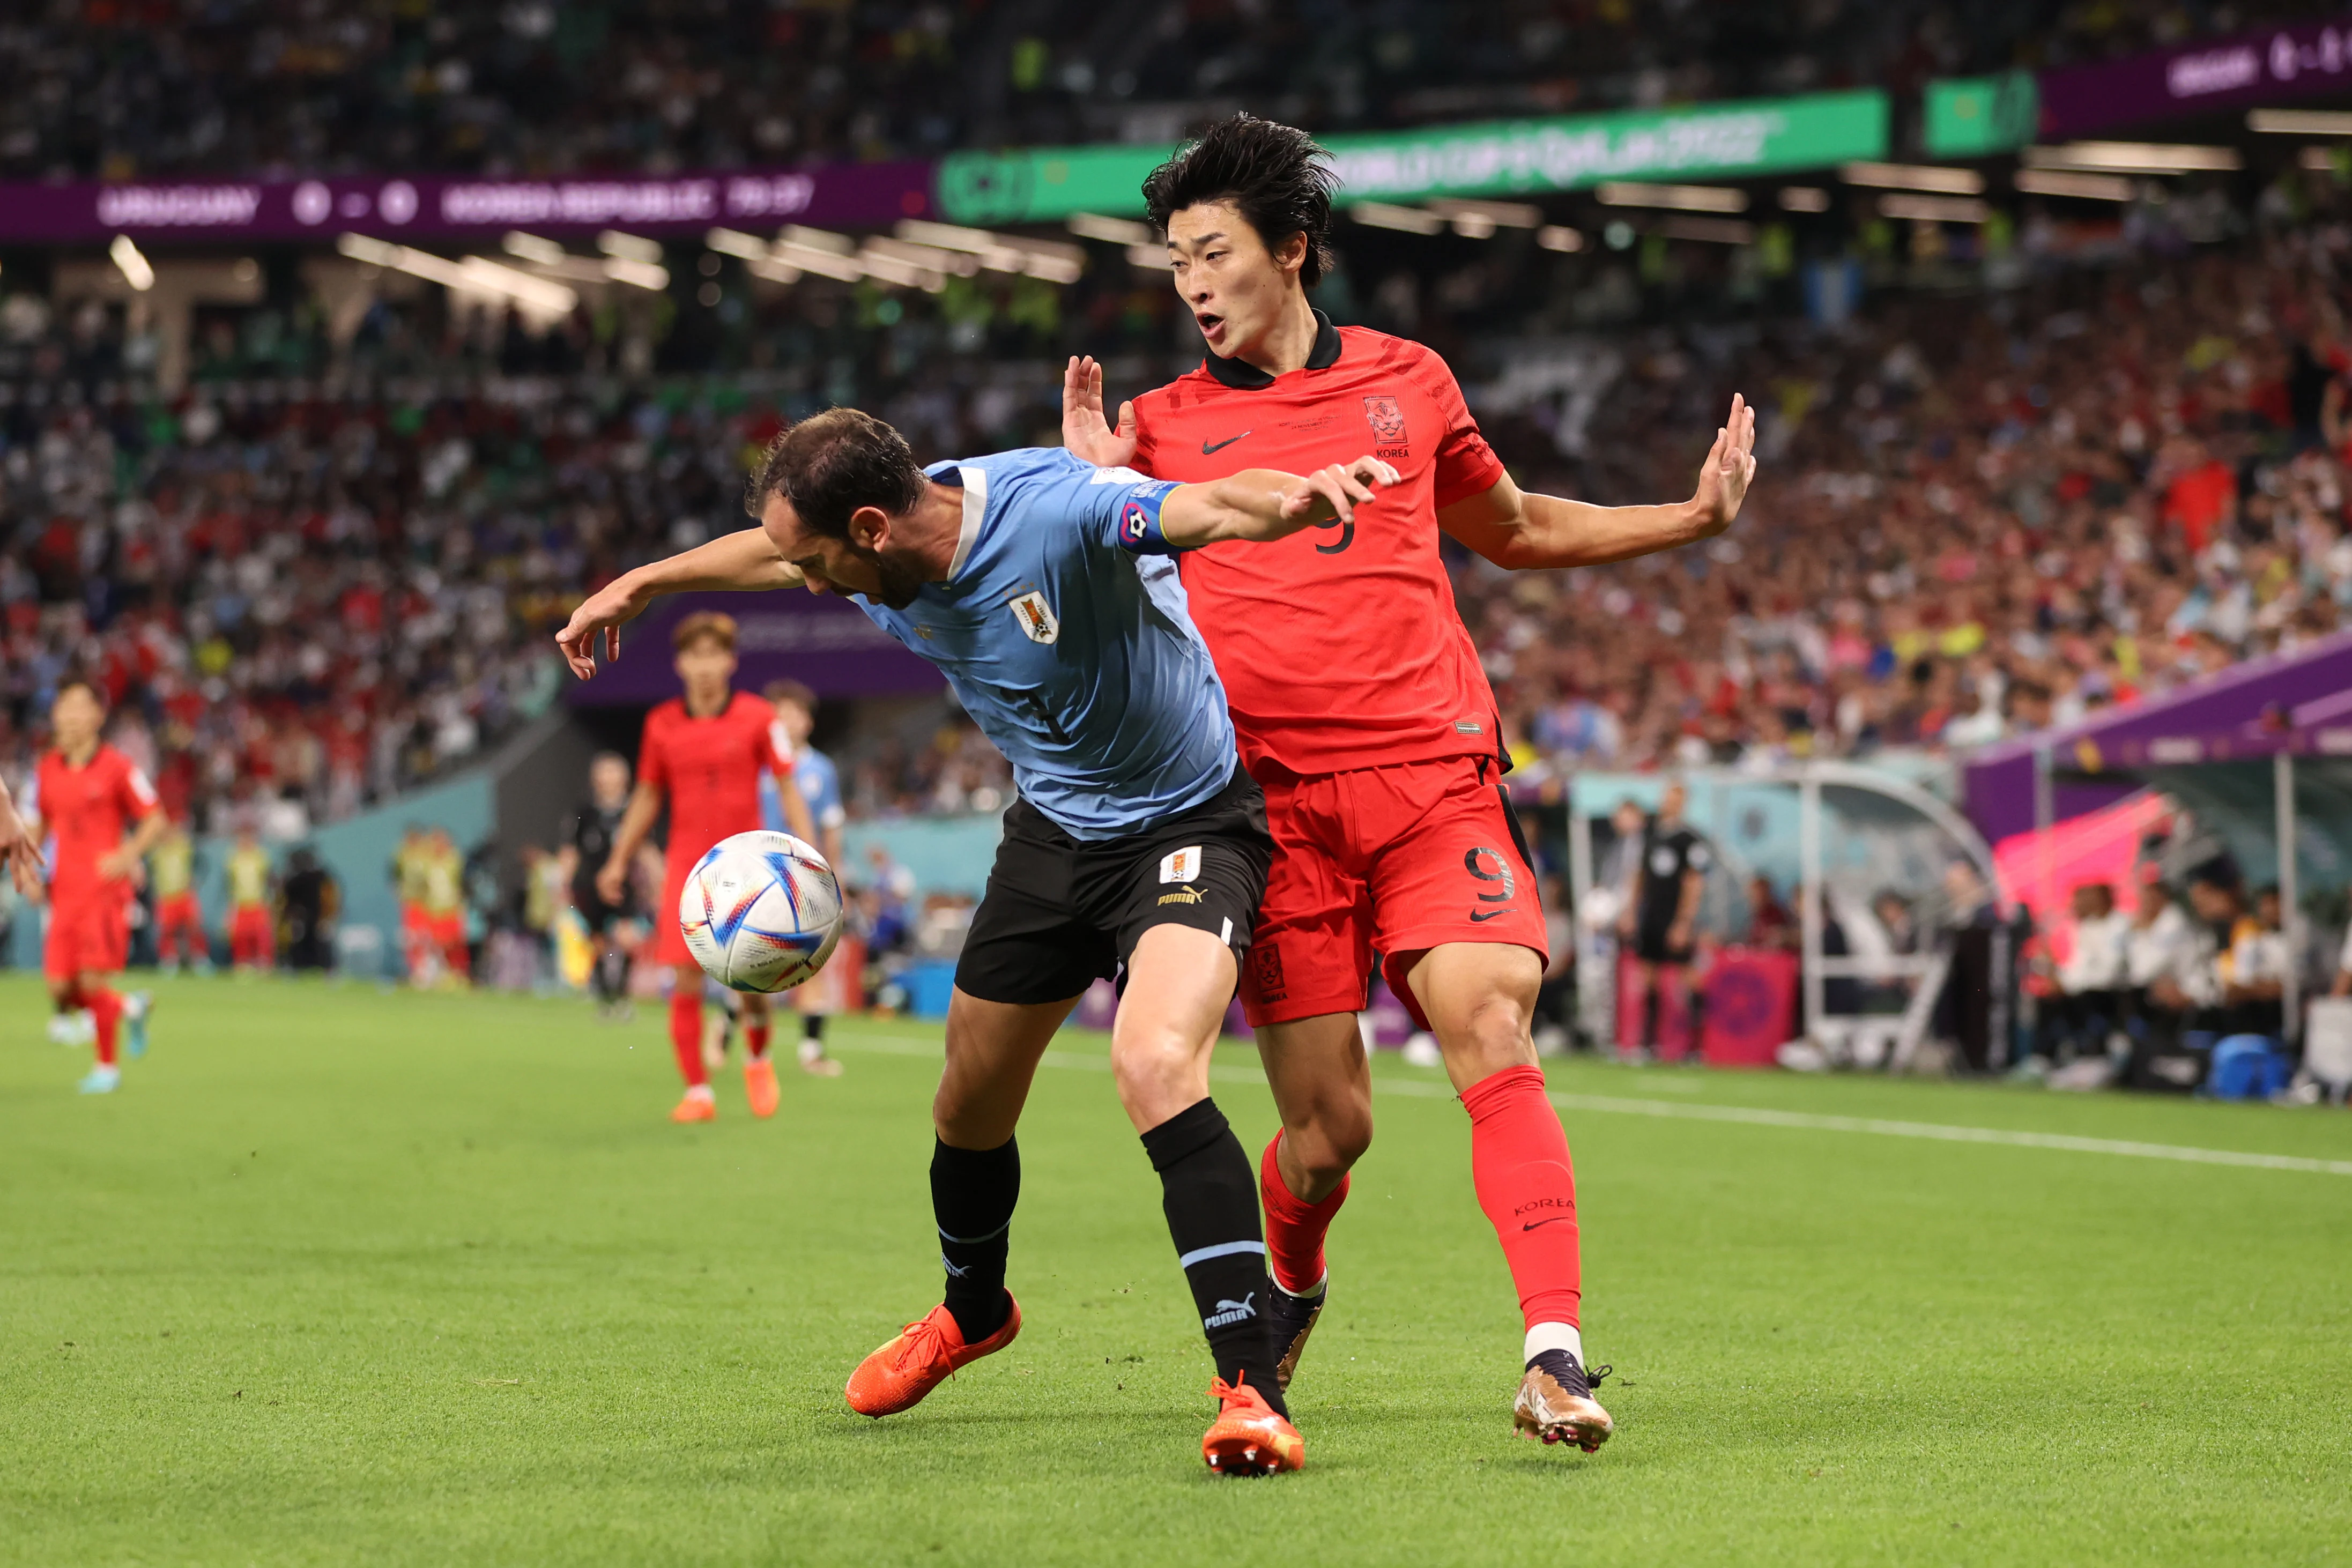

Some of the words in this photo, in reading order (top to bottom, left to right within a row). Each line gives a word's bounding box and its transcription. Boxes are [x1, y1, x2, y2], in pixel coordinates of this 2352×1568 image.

[98, 185, 261, 226] URUGUAY
[441, 183, 558, 224] KOREA
[558, 180, 717, 223] REPUBLIC
[1376, 449, 1409, 458] KOREA
[1464, 847, 1515, 902] 9
[1158, 893, 1196, 906] PUMA
[1515, 1198, 1575, 1217] KOREA
[1205, 1309, 1248, 1330] PUMA
